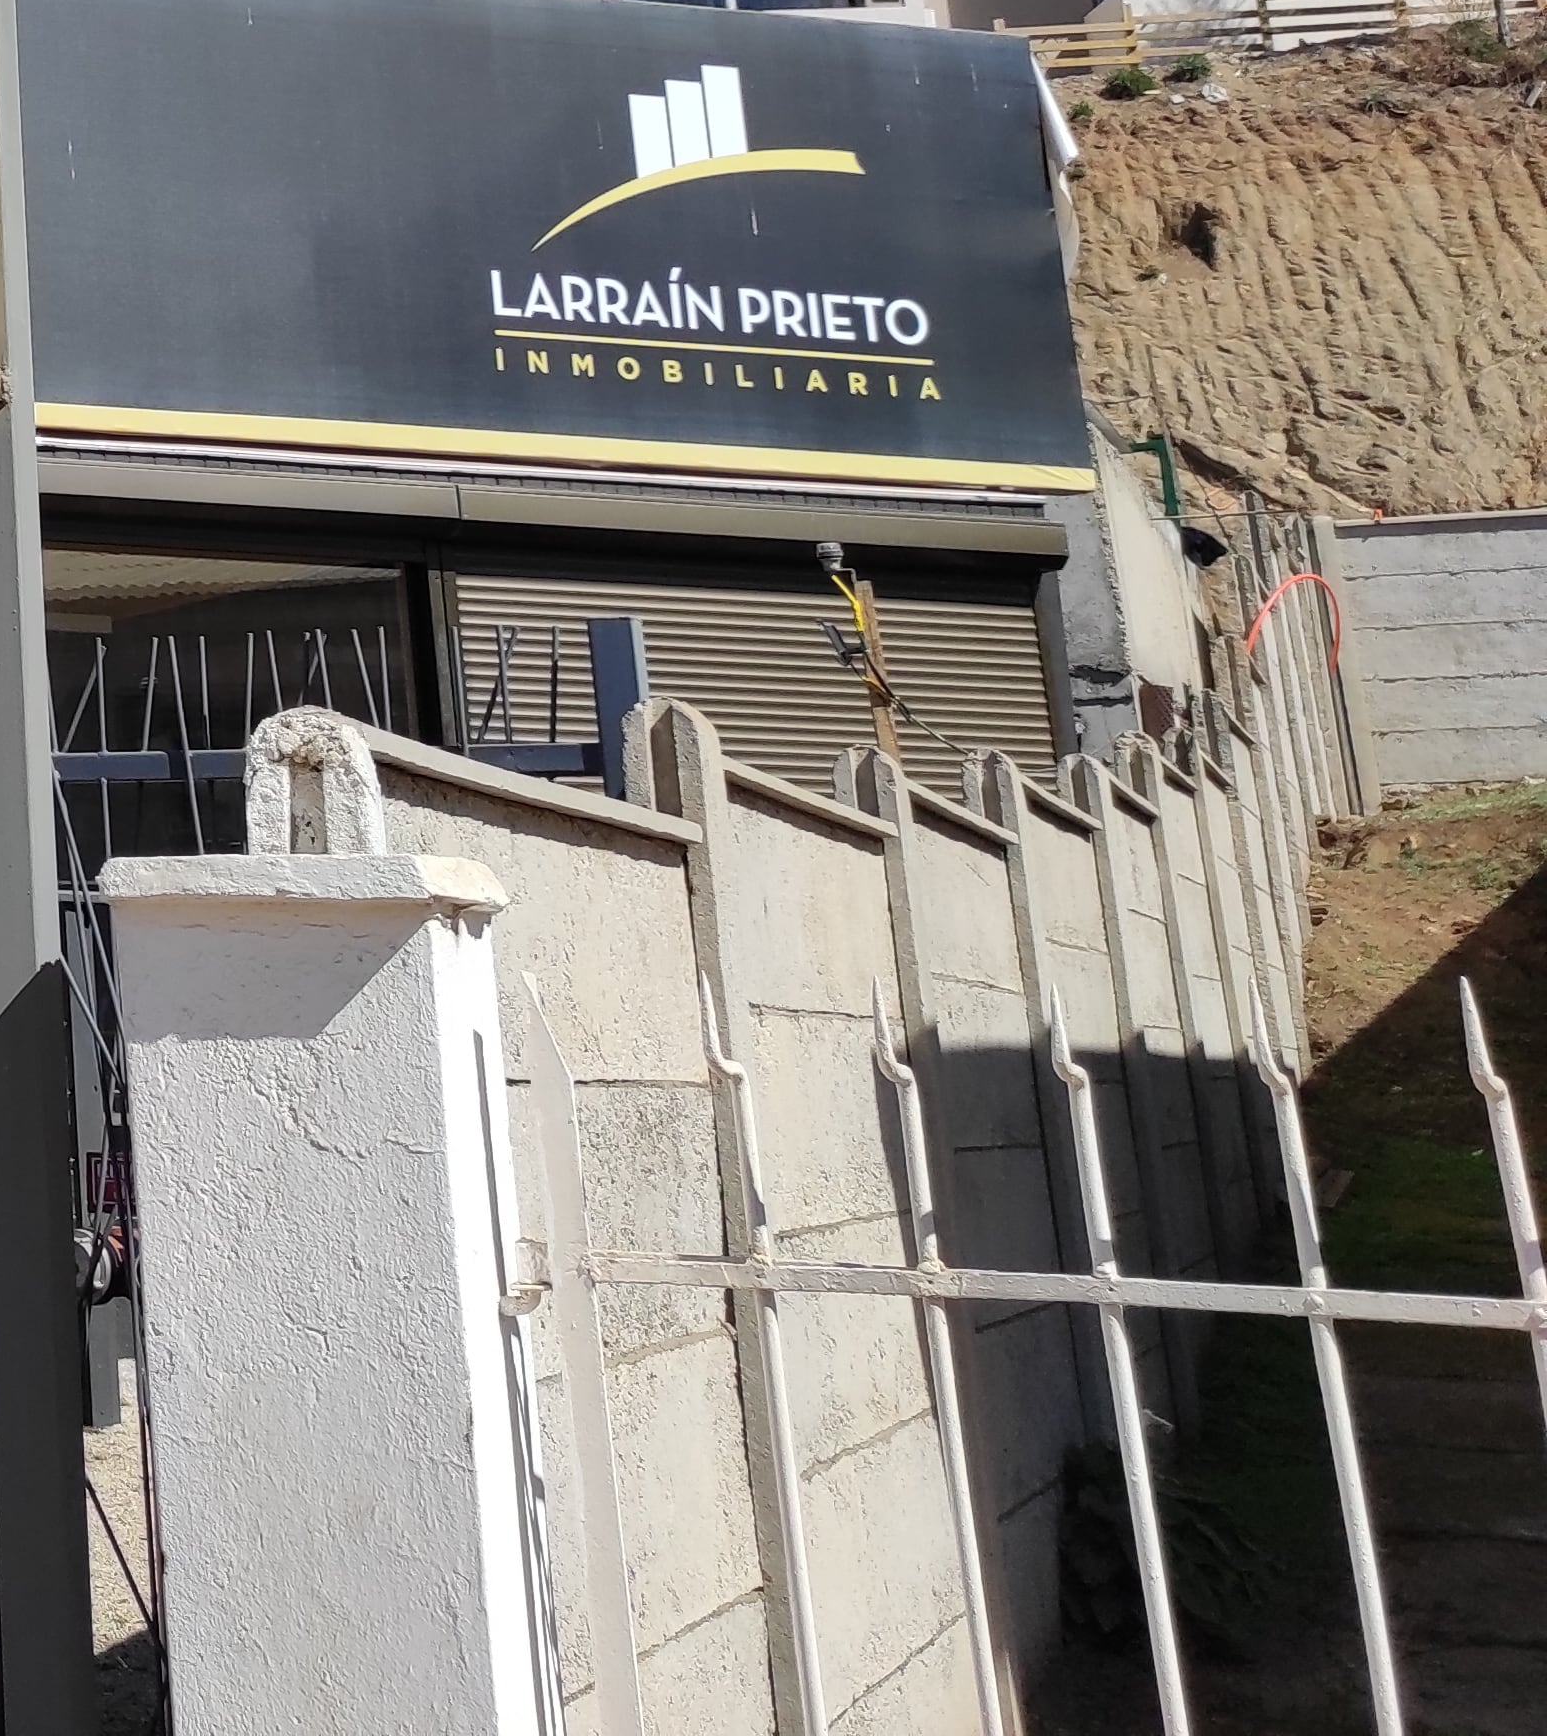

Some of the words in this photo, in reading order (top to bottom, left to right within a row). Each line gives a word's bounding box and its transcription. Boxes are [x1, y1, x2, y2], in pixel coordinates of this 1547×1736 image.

[490, 267, 725, 333] LARRAÍN
[738, 287, 930, 346] PRIETO
[495, 347, 942, 401] INMOBILIARIA
